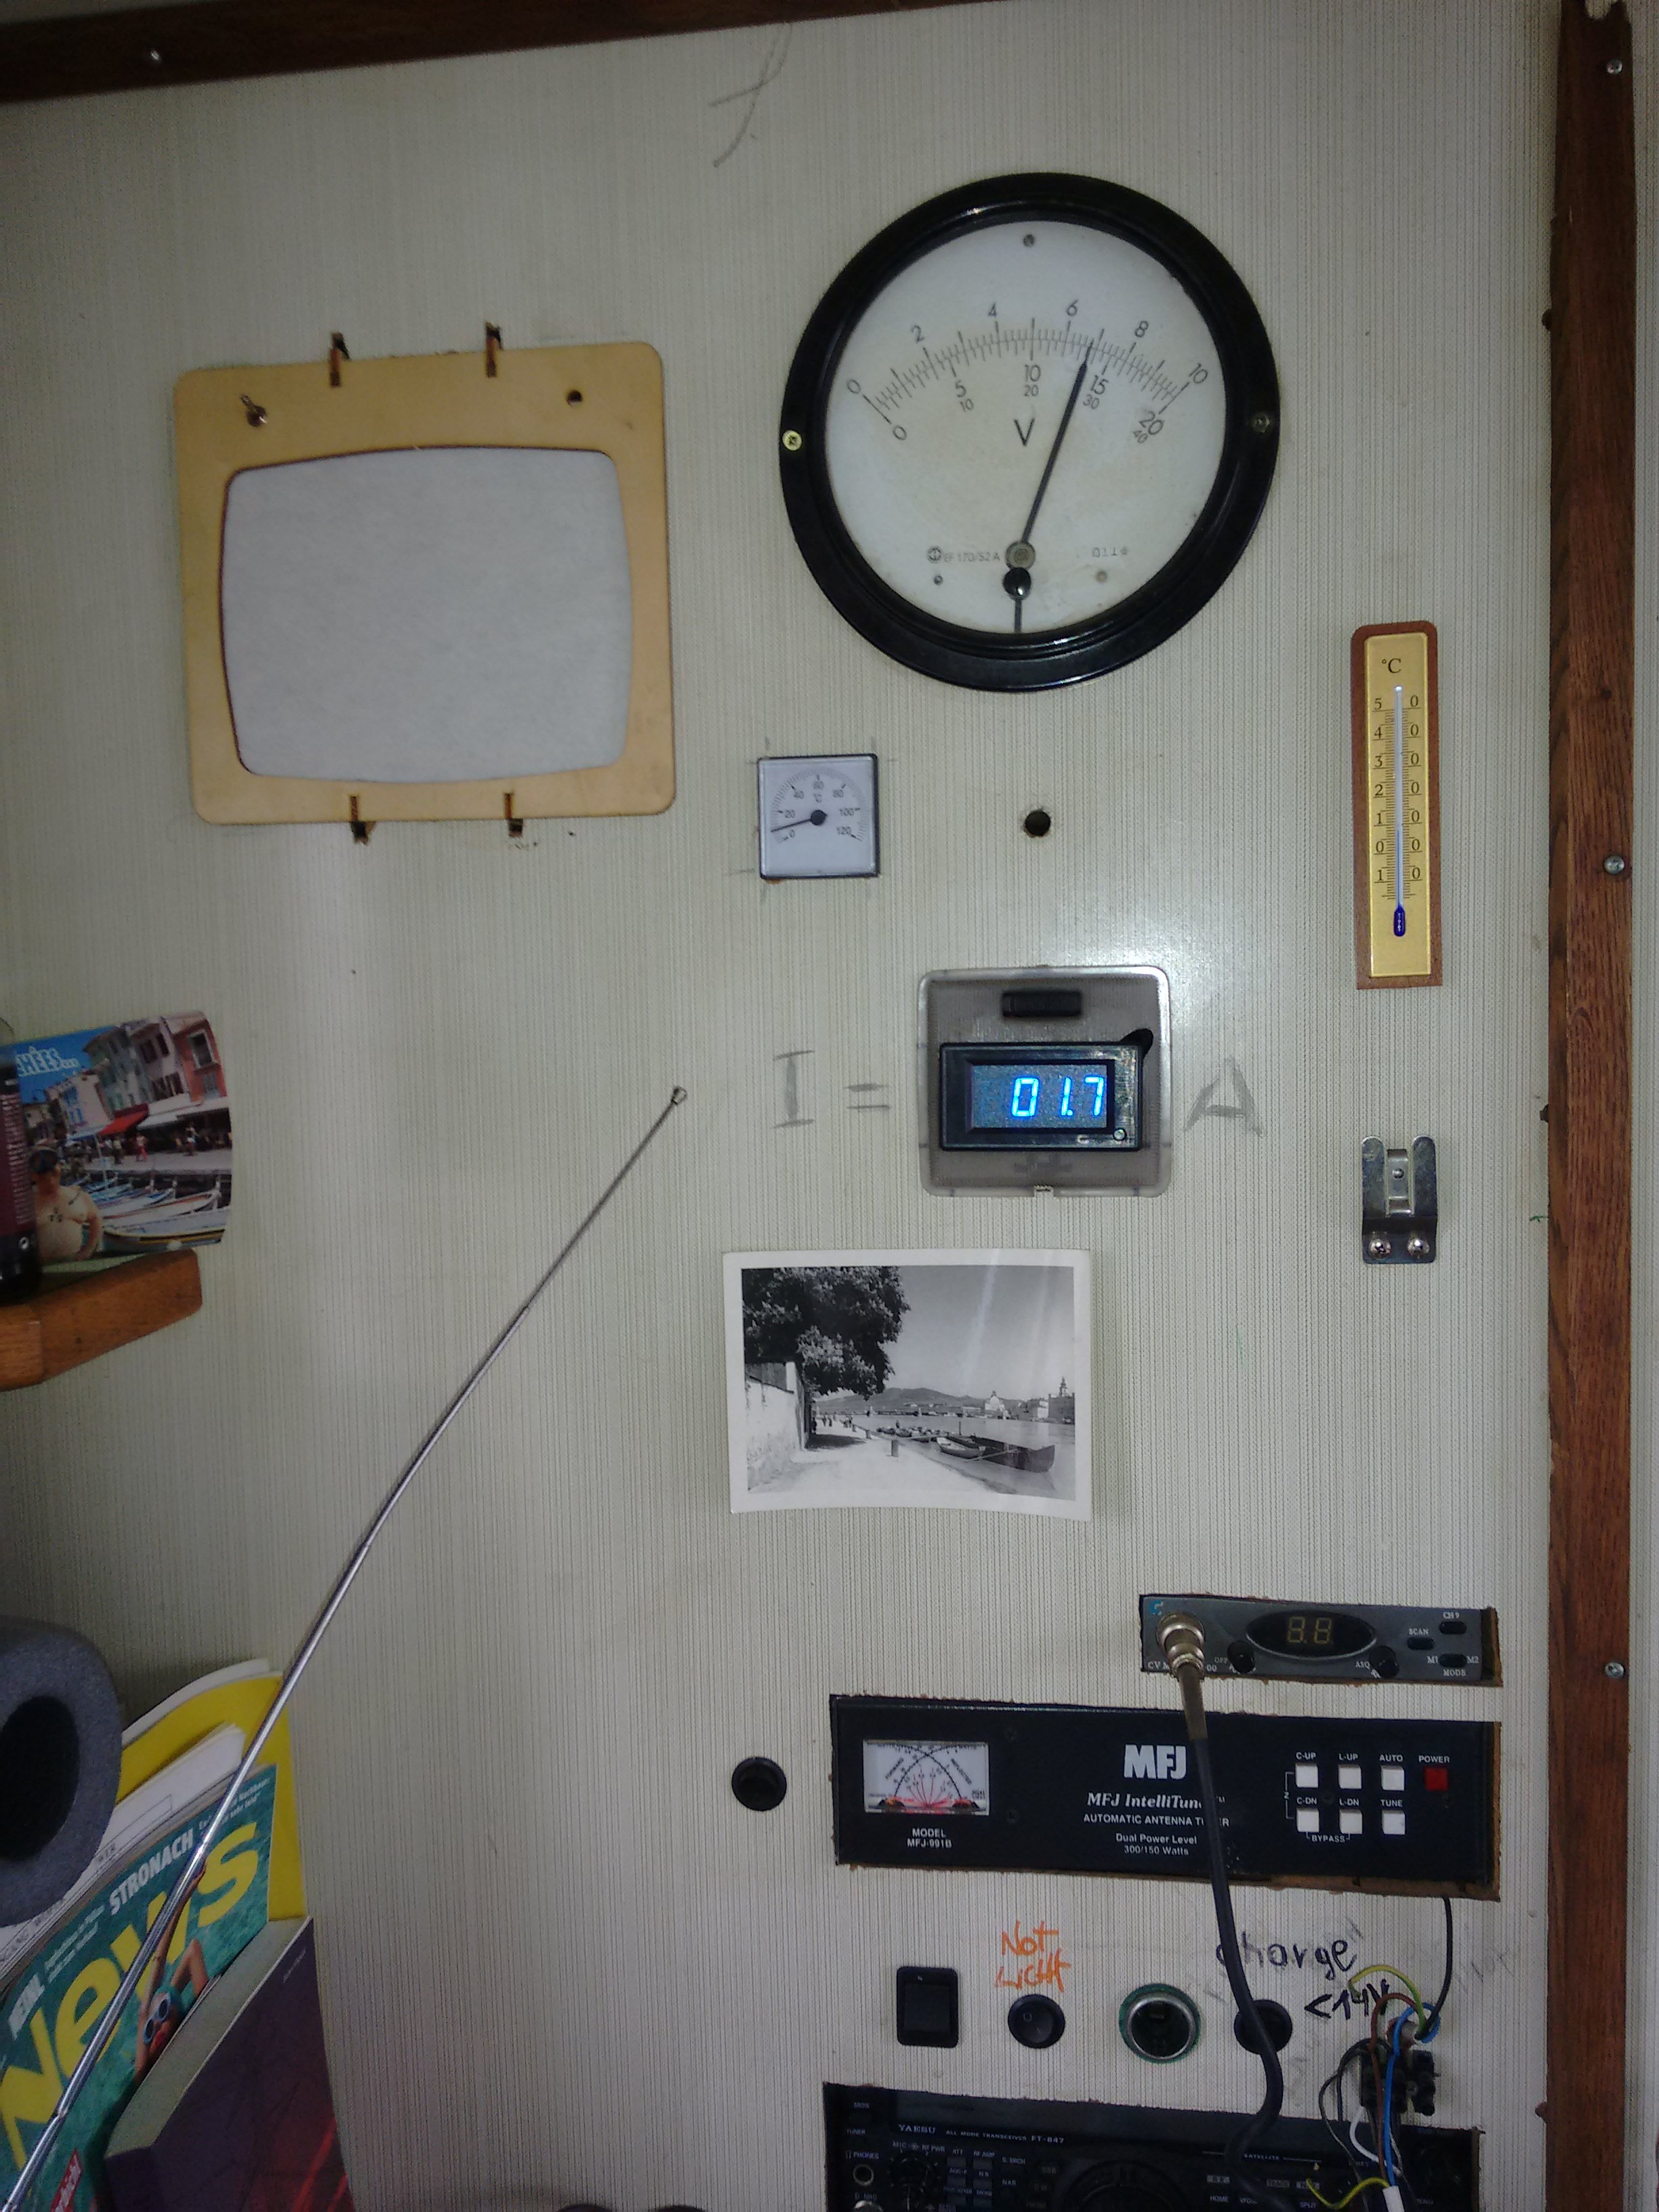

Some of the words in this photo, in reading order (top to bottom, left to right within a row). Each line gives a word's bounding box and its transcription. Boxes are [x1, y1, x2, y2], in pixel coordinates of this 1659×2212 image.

[988, 302, 998, 317] 4
[1066, 300, 1078, 316] 6
[911, 324, 925, 343] 2
[1134, 321, 1149, 337] 8
[1024, 364, 1042, 382] 10
[1188, 363, 1209, 384] 10
[847, 379, 861, 394] 0
[955, 380, 967, 398] 5
[1024, 384, 1039, 396] 20
[1090, 375, 1109, 395] 15
[960, 398, 974, 412] 10
[1083, 394, 1100, 409] 30
[1139, 410, 1164, 435] 20
[893, 425, 907, 441] 0
[1014, 418, 1036, 447] V
[1409, 1628, 1429, 1636] SCAN
[1443, 1668, 1467, 1677] MODE
[1124, 1744, 1187, 1780] MFJ
[1296, 1751, 1317, 1761] C-UP
[1338, 1753, 1359, 1761] L-UP
[1379, 1754, 1404, 1763] AUTO
[1418, 1755, 1451, 1764] POWER
[1087, 1791, 1121, 1807] MFJ
[1296, 1797, 1317, 1805] C-DN
[1339, 1798, 1359, 1807] L-DN
[1380, 1799, 1404, 1807] TUNE
[1083, 1813, 1143, 1824] AUTOMATIC
[1144, 1816, 1193, 1826] ANTENNA
[912, 1827, 947, 1838] MODEL
[1115, 1832, 1137, 1843] Dual
[1139, 1833, 1171, 1844] Power
[1172, 1835, 1197, 1845] Level
[1311, 1834, 1346, 1844] BYPASS
[1124, 1844, 1160, 1856] 300/150
[1162, 1845, 1189, 1856] Watts
[108, 1830, 194, 1917] STRONACH
[853, 2102, 871, 2110] MOX
[898, 2123, 937, 2135] YAESU
[983, 2133, 1027, 2142] TRANSCEIVER
[853, 2151, 880, 2160] PHONES
[1243, 2152, 1281, 2161] SATELLITE
